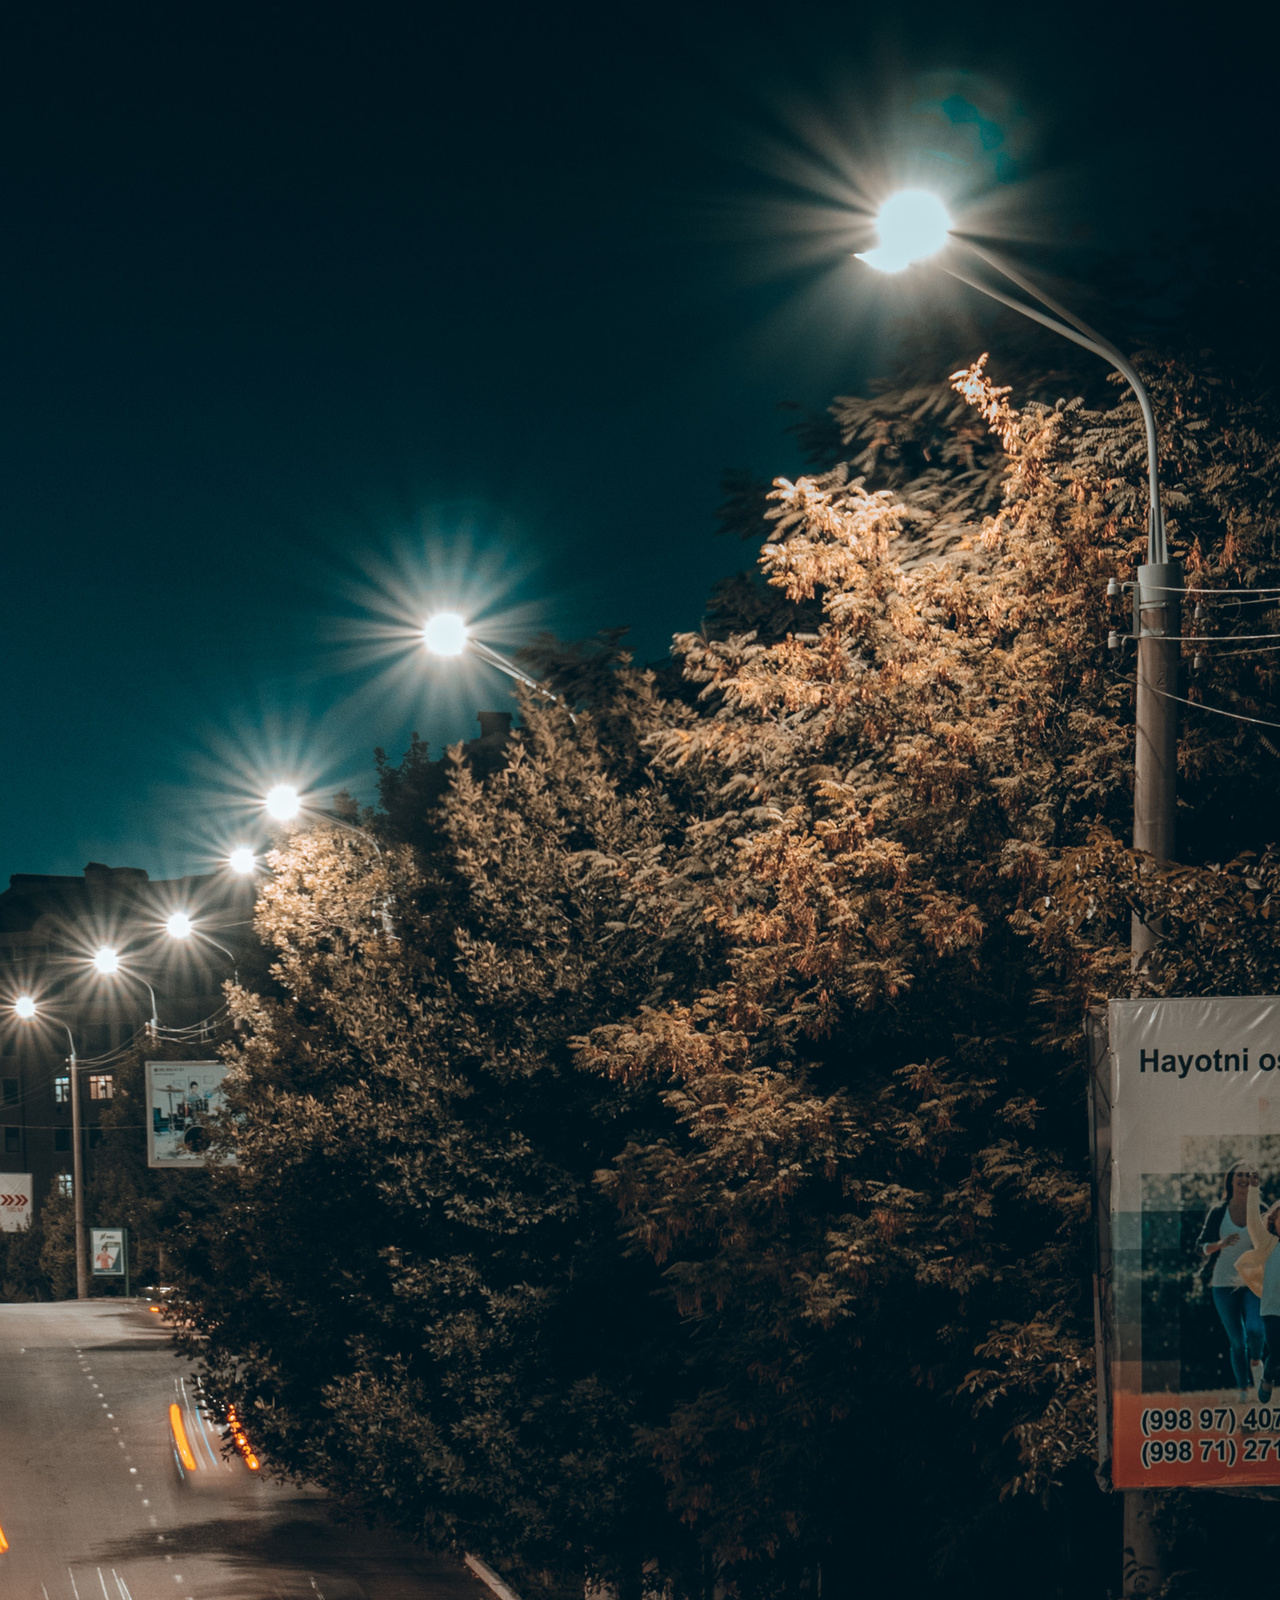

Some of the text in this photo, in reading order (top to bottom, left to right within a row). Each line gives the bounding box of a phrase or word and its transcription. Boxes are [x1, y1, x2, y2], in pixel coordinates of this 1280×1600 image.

[1140, 1048, 1280, 1078] Hayotni o
[1140, 1408, 1194, 1438] (998
[1199, 1407, 1237, 1435] 97)
[1140, 1439, 1194, 1470] (998
[1199, 1438, 1238, 1467] 71)
